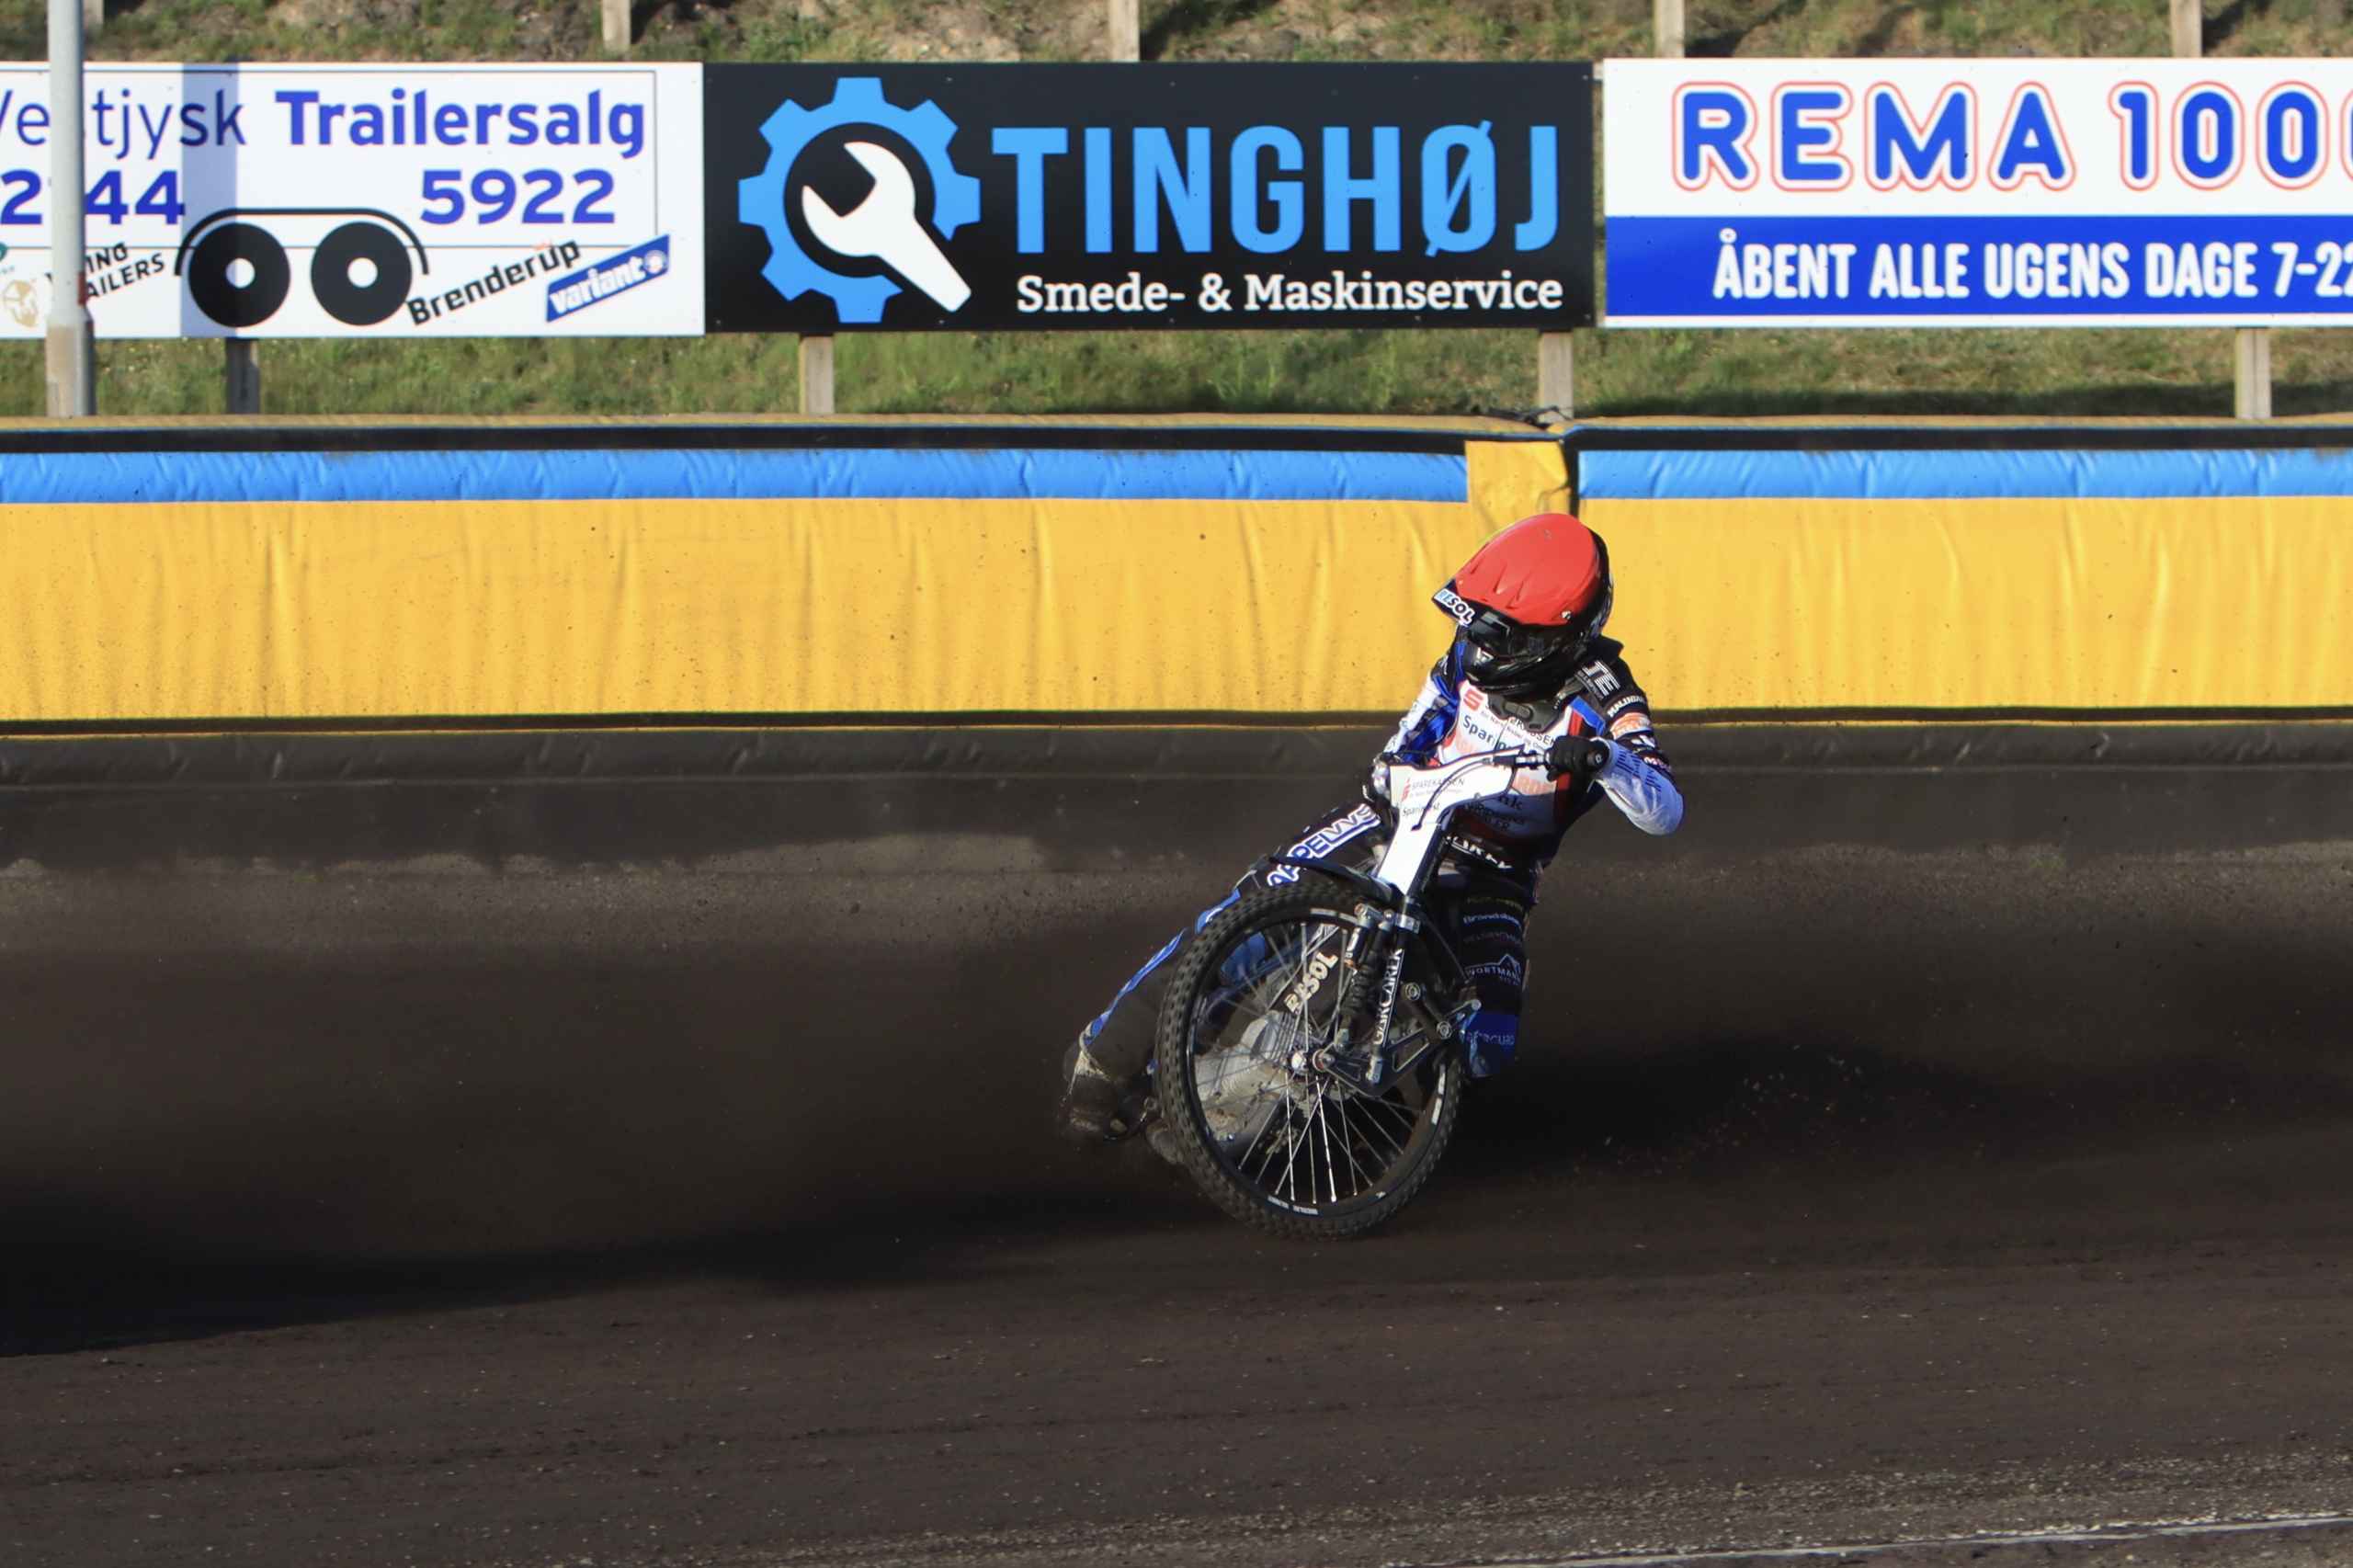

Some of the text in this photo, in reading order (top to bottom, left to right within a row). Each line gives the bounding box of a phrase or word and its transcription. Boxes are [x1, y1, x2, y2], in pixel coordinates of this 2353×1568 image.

[275, 88, 644, 158] Trailersalg
[1672, 80, 2353, 192] REMA 100
[0, 168, 615, 231] 244 5922
[992, 120, 1559, 257] TINGHØJ
[85, 253, 165, 299] AILERS
[1018, 270, 1563, 312] Smede- & Maskinservice
[1714, 229, 1856, 298] ÅBENT
[1870, 244, 1969, 298] ALLE
[1985, 243, 2129, 298] UGENS
[2146, 243, 2257, 297] DAGE
